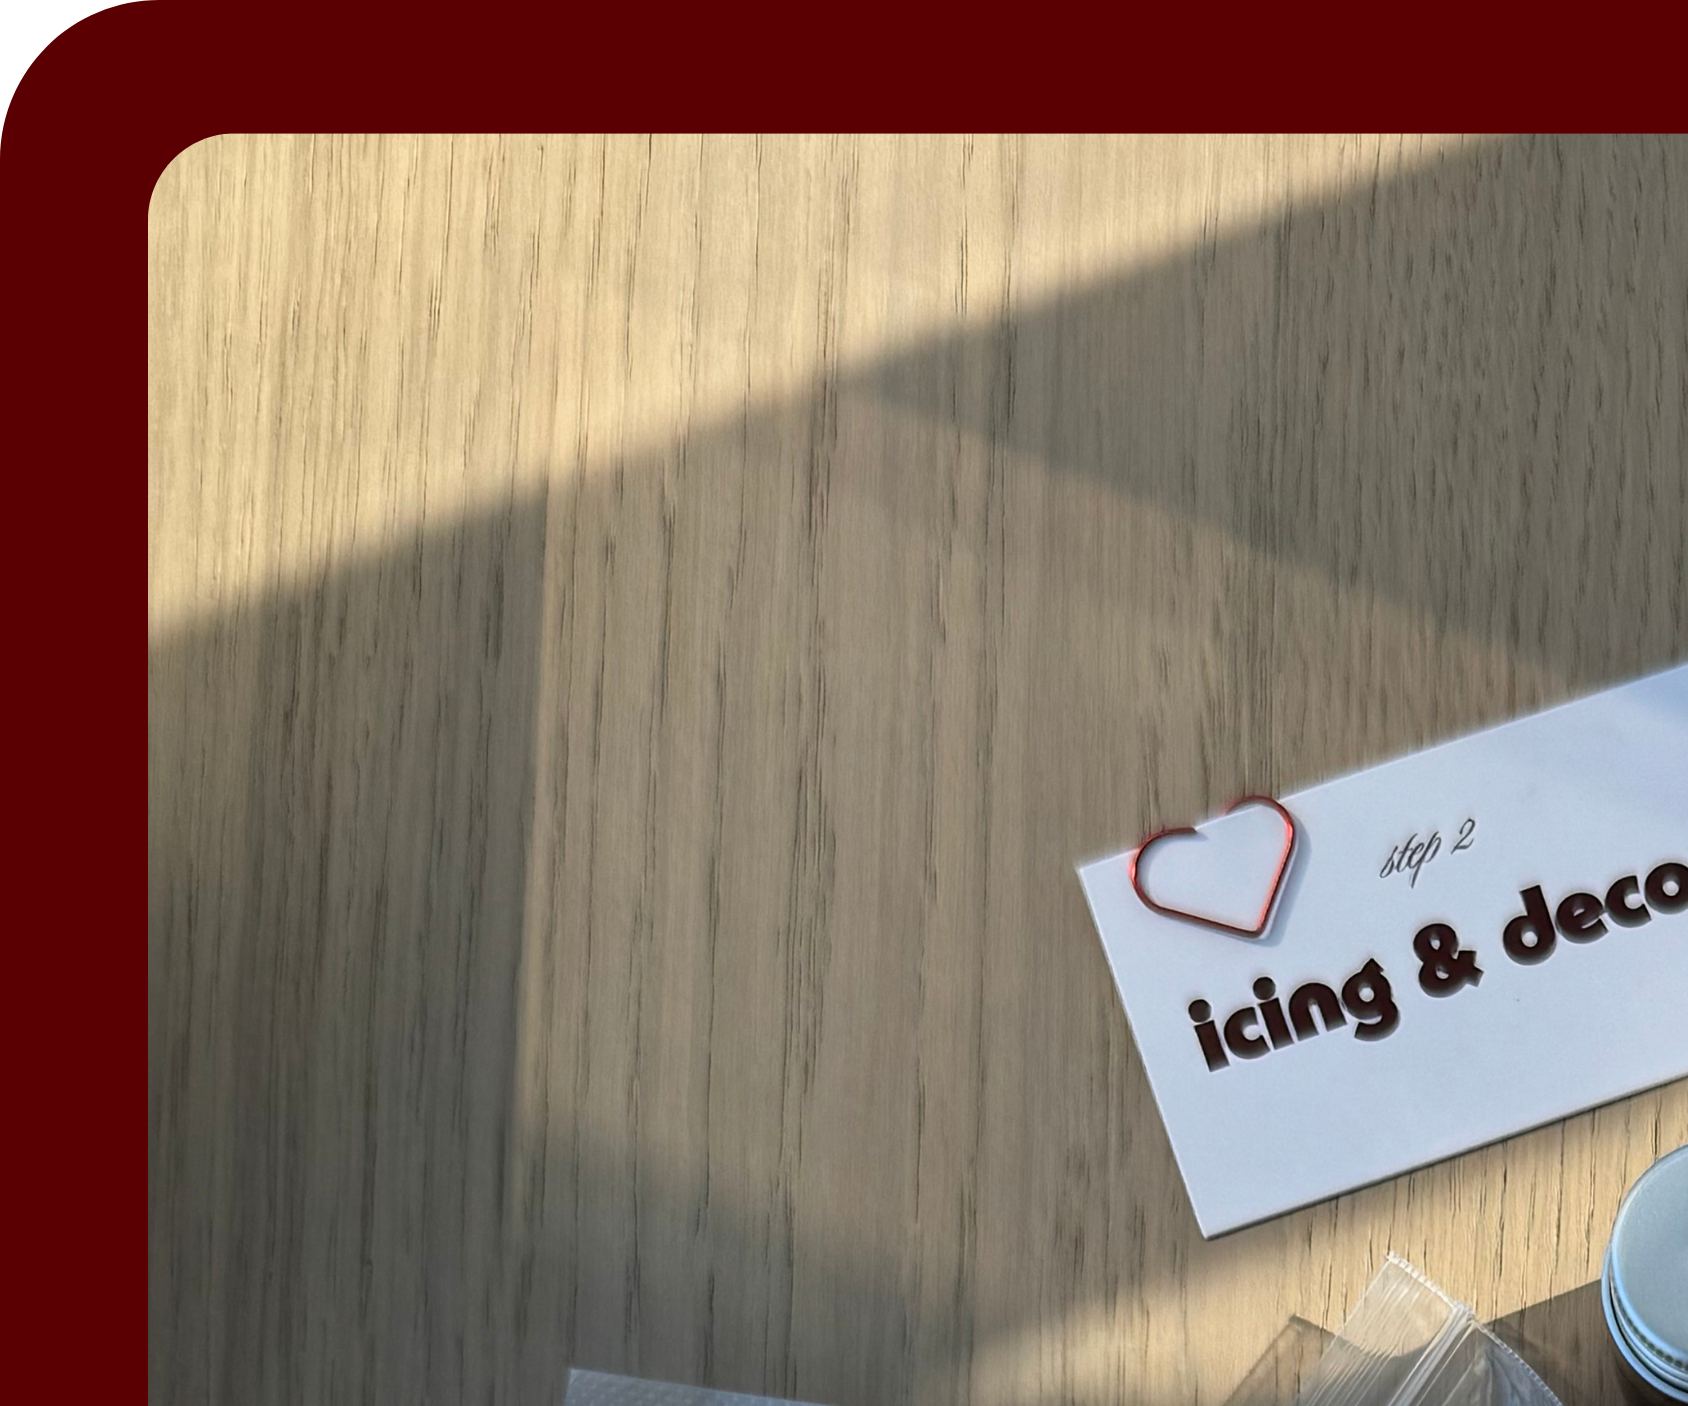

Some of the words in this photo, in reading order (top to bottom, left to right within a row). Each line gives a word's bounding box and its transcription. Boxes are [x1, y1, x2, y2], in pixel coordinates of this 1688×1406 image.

[1379, 830, 1442, 889] step
[1450, 817, 1476, 855] 2
[1187, 957, 1400, 1073] icing
[1412, 922, 1484, 998] &
